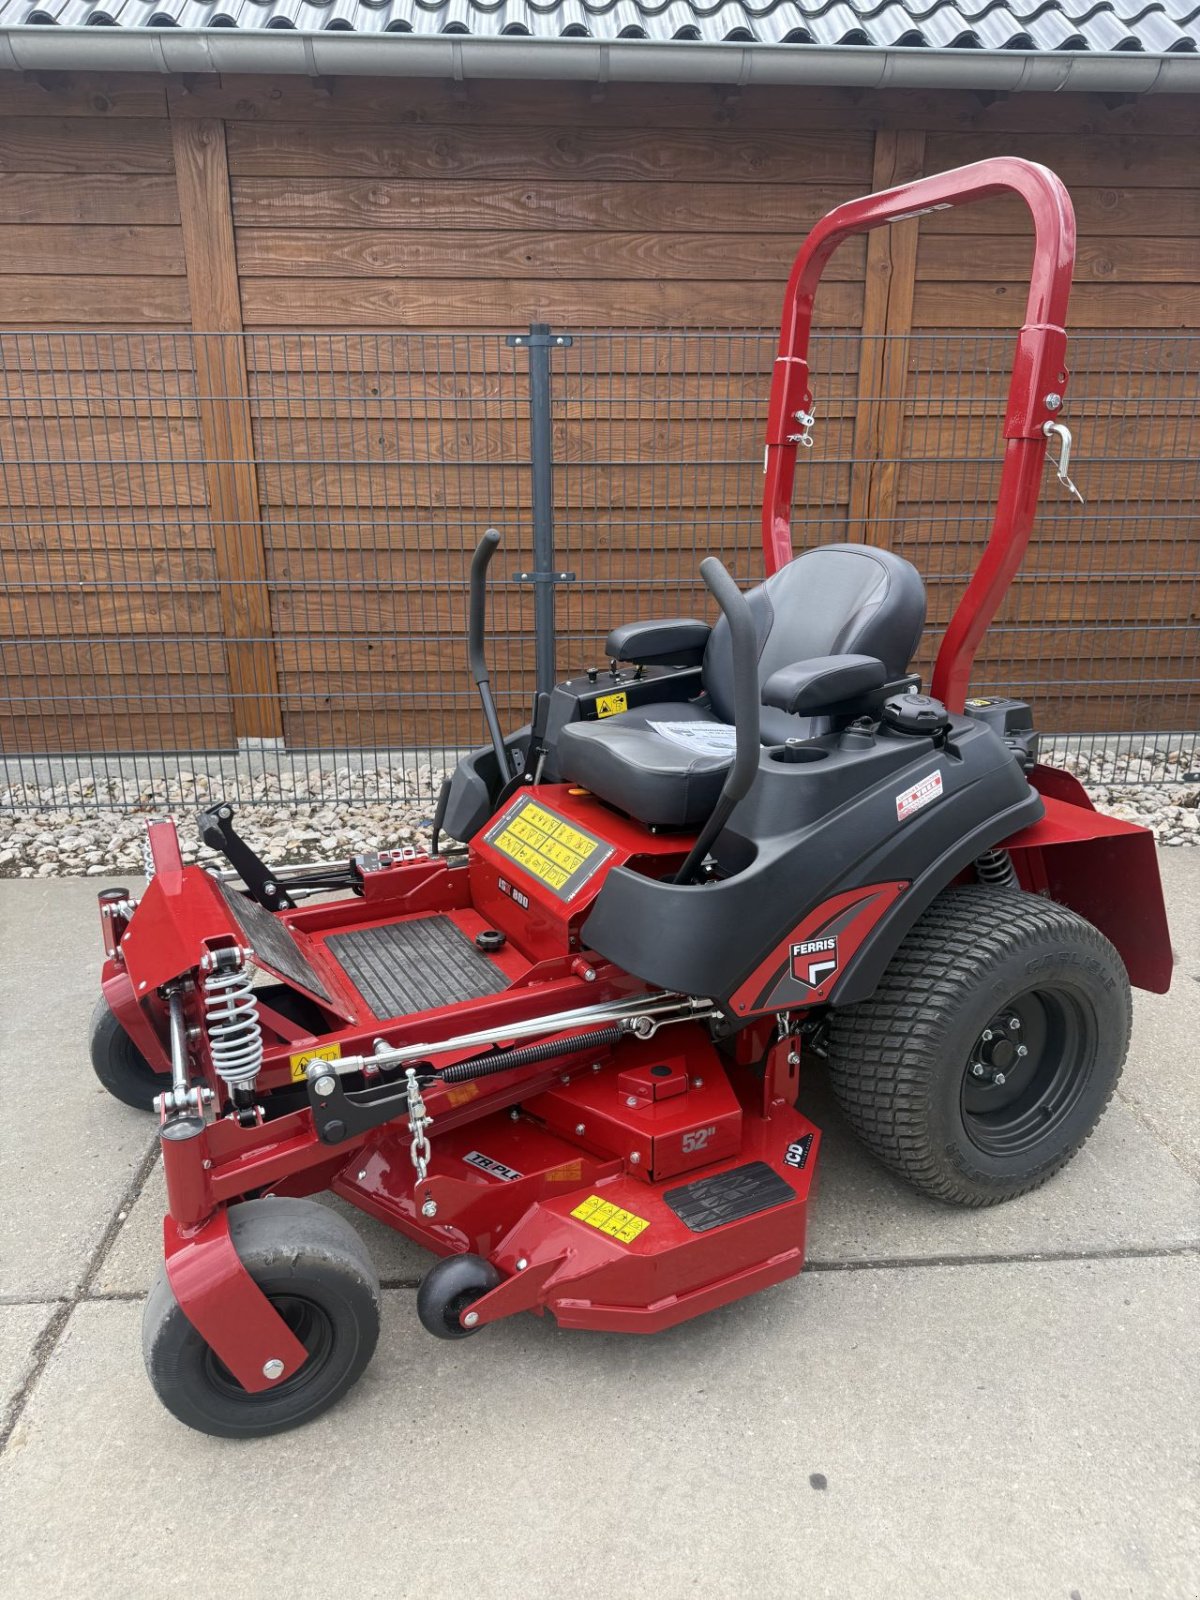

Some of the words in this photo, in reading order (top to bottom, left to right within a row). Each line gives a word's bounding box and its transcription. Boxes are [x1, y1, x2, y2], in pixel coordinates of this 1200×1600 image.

[793, 938, 836, 956] FERRIS
[682, 1126, 717, 1154] 52"
[472, 1153, 522, 1180] TRIPLE
